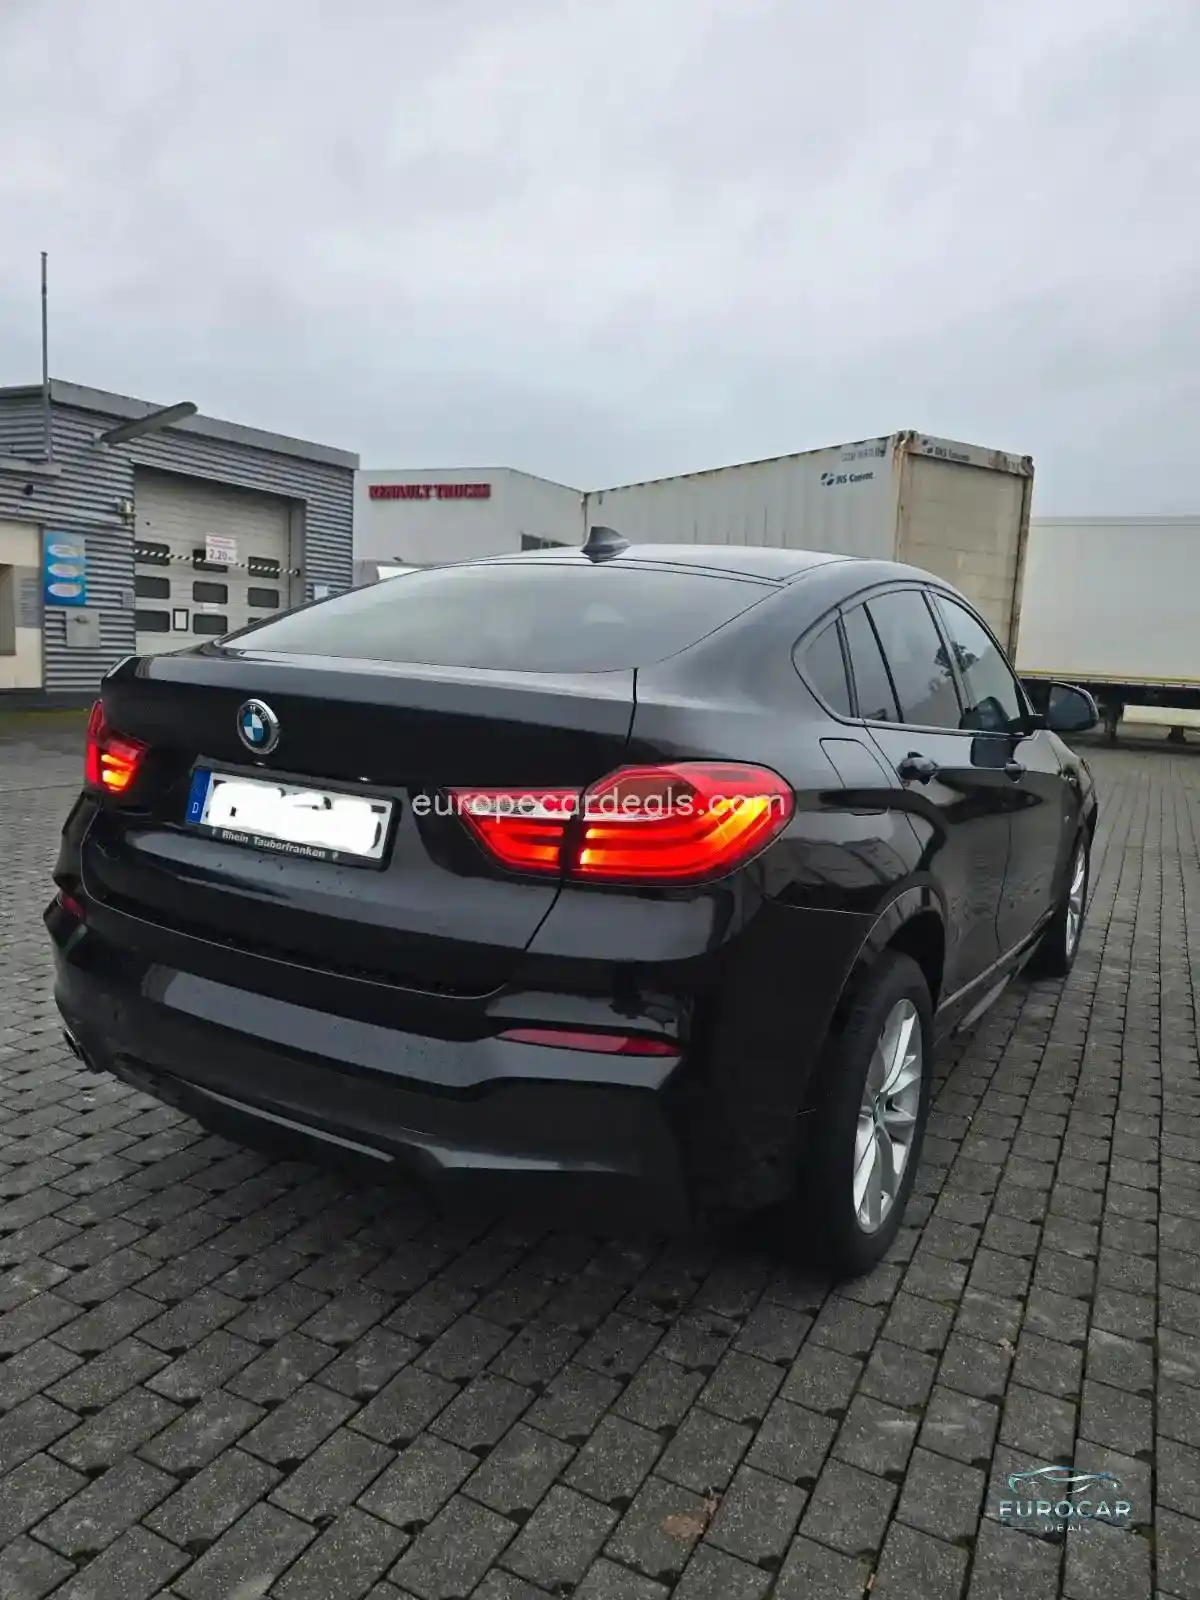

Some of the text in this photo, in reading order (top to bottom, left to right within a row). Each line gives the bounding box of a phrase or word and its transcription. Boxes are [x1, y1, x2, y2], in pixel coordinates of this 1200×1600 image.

[192, 802, 199, 813] D
[222, 830, 326, 858] Rhein Tauberfranken
